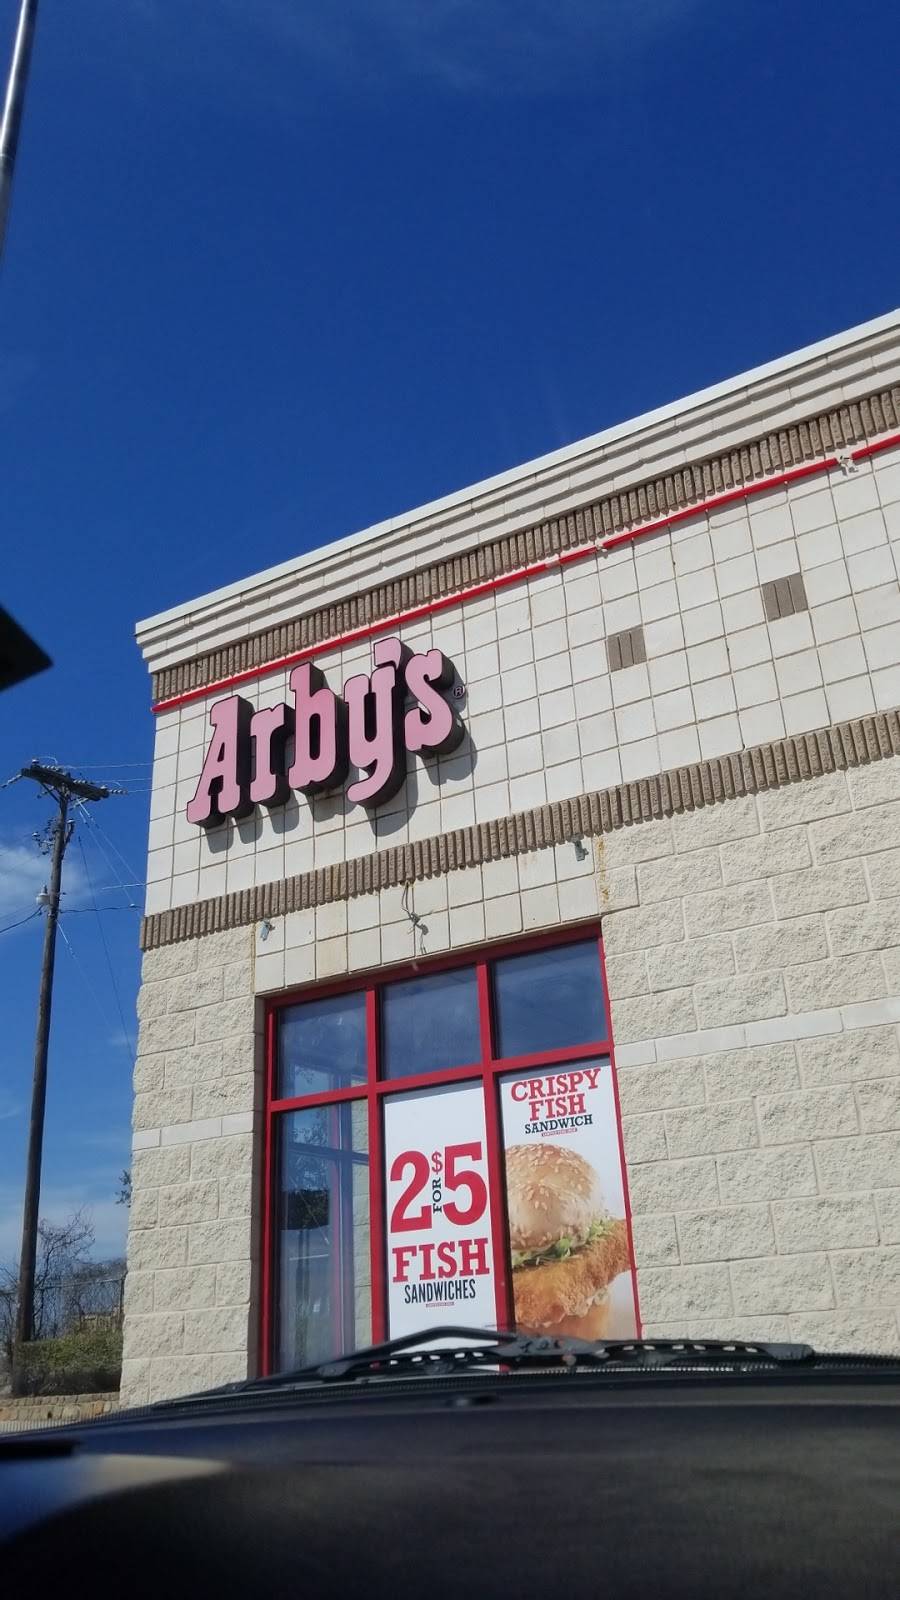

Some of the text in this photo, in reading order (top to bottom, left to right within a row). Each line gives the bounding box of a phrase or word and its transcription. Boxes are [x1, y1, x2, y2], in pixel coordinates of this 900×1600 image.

[186, 637, 458, 827] Arby's
[511, 1068, 601, 1102] CRISPY
[525, 1114, 593, 1135] SANDWICH
[529, 1093, 586, 1122] FISH
[390, 1150, 432, 1234] 2
[432, 1177, 442, 1213] FOR
[392, 1238, 490, 1283] FISH
[404, 1278, 476, 1304] SANDWICHES
